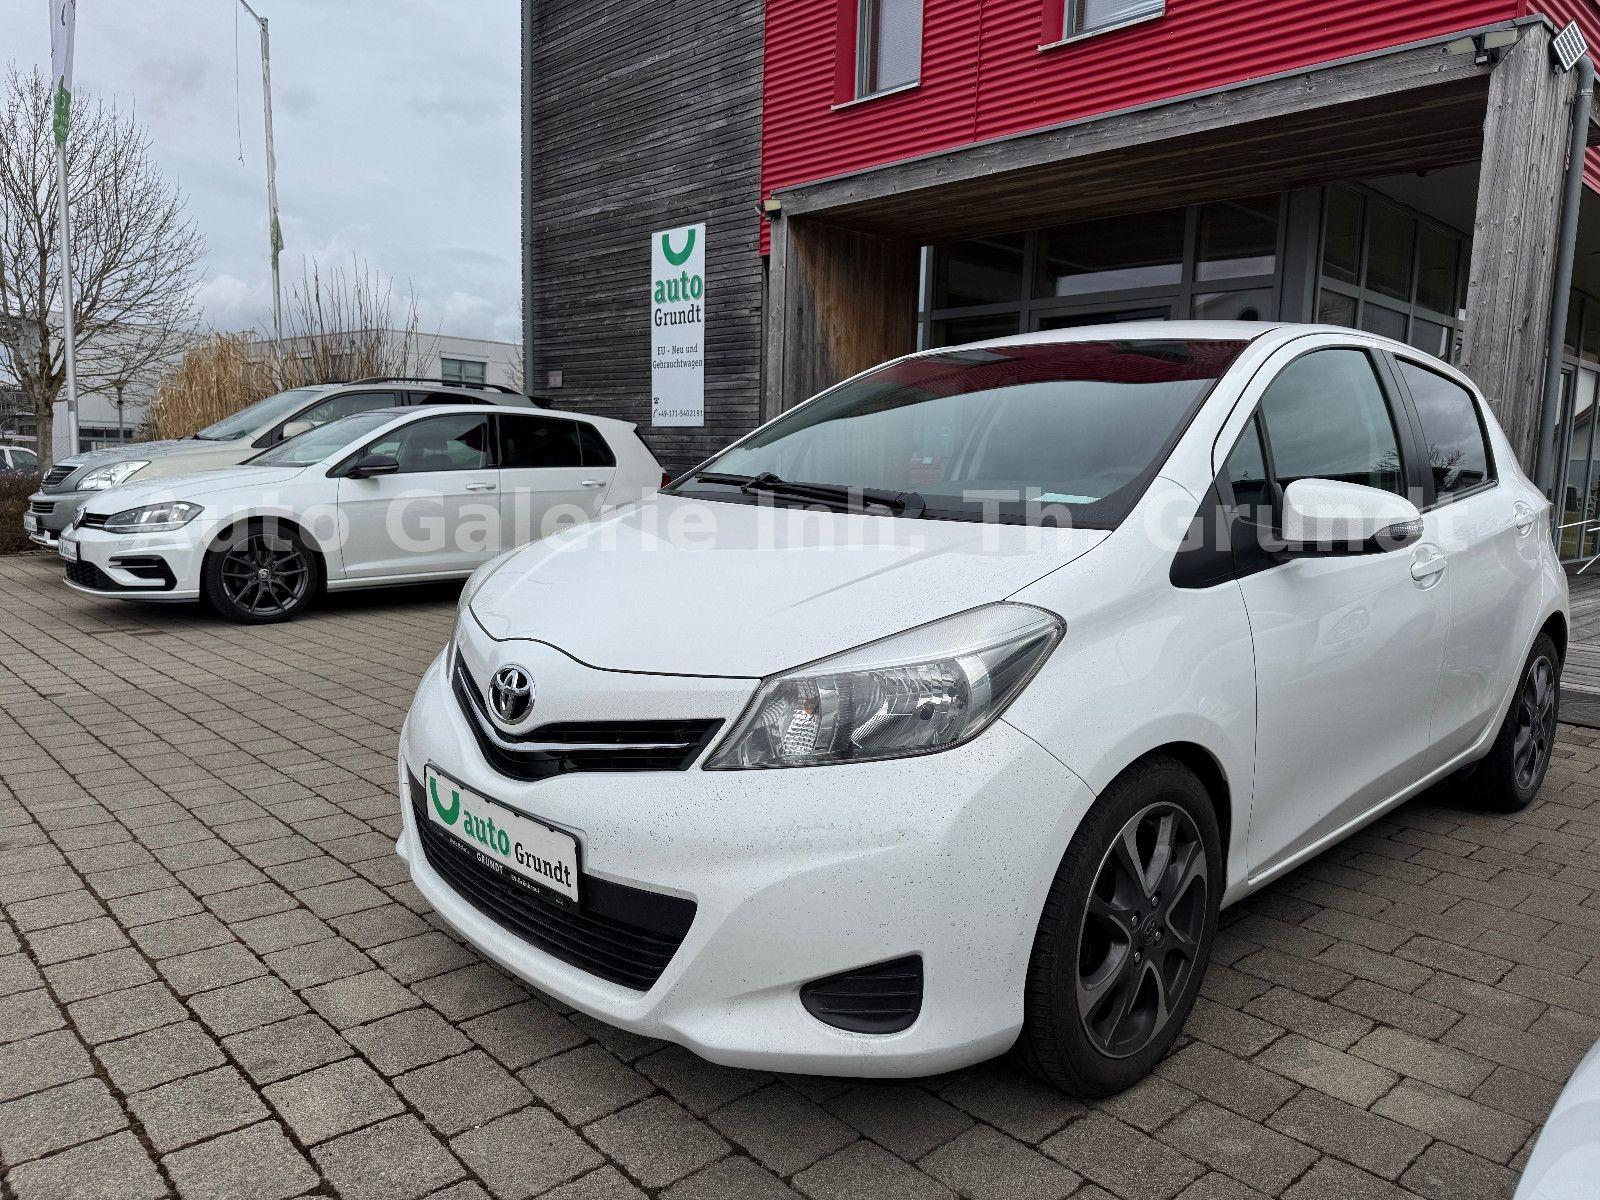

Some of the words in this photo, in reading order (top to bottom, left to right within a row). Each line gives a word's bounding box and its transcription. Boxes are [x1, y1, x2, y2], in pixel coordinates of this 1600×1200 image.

[654, 270, 704, 305] auto
[654, 303, 702, 327] Grundt
[657, 345, 666, 356] EU
[671, 344, 684, 355] Neu
[685, 342, 698, 354] und
[652, 358, 703, 370] Gebrauchtwagen
[462, 809, 512, 857] auto
[476, 852, 504, 875] GRUNDT
[514, 841, 572, 888] Grundt
